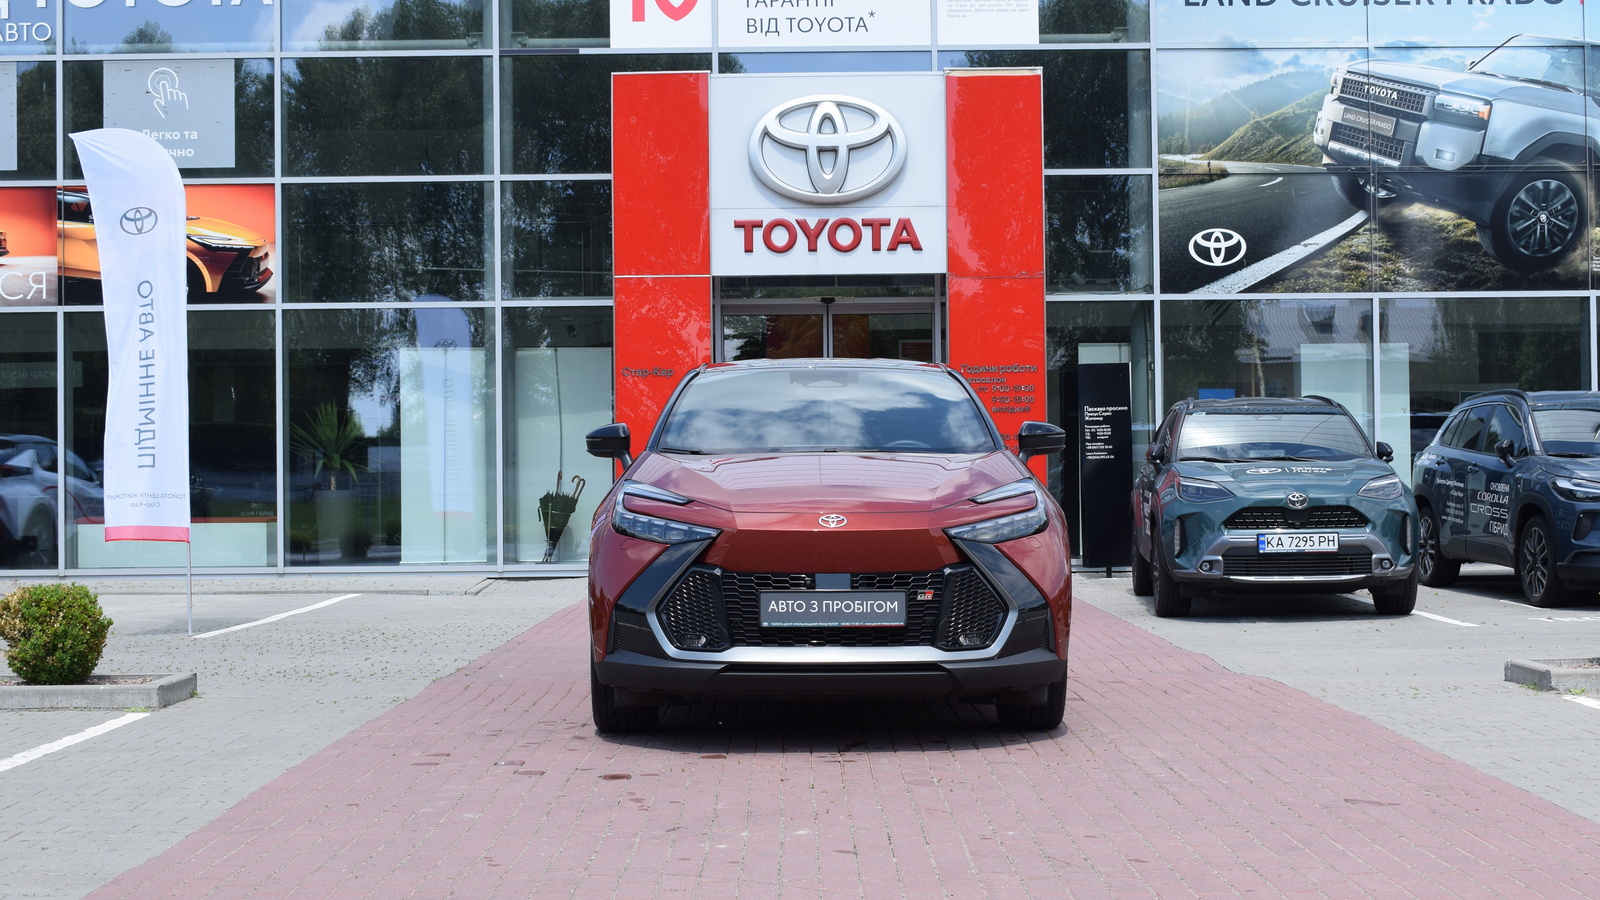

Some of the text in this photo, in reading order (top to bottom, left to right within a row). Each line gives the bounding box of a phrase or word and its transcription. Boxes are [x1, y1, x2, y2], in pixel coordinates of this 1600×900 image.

[0, 22, 52, 42] ВТО
[746, 18, 780, 37] ВІД
[1364, 85, 1397, 99] TOYOTA
[1356, 116, 1376, 125] CRUISER
[1375, 120, 1392, 130] PRADO
[183, 131, 198, 139] та
[733, 217, 923, 254] TOYOTA
[0, 271, 47, 300] СЯ
[621, 366, 675, 378] Стар-Кар
[961, 363, 1037, 374] Години роботи
[991, 405, 1031, 413] вихідний
[1477, 491, 1509, 504] COROLLA
[1470, 503, 1508, 519] CROSS
[1266, 535, 1336, 548] KA 7295 PH
[917, 592, 933, 600] GR
[768, 600, 806, 613] АВТО
[822, 600, 898, 613] ПРОБІГОМ
